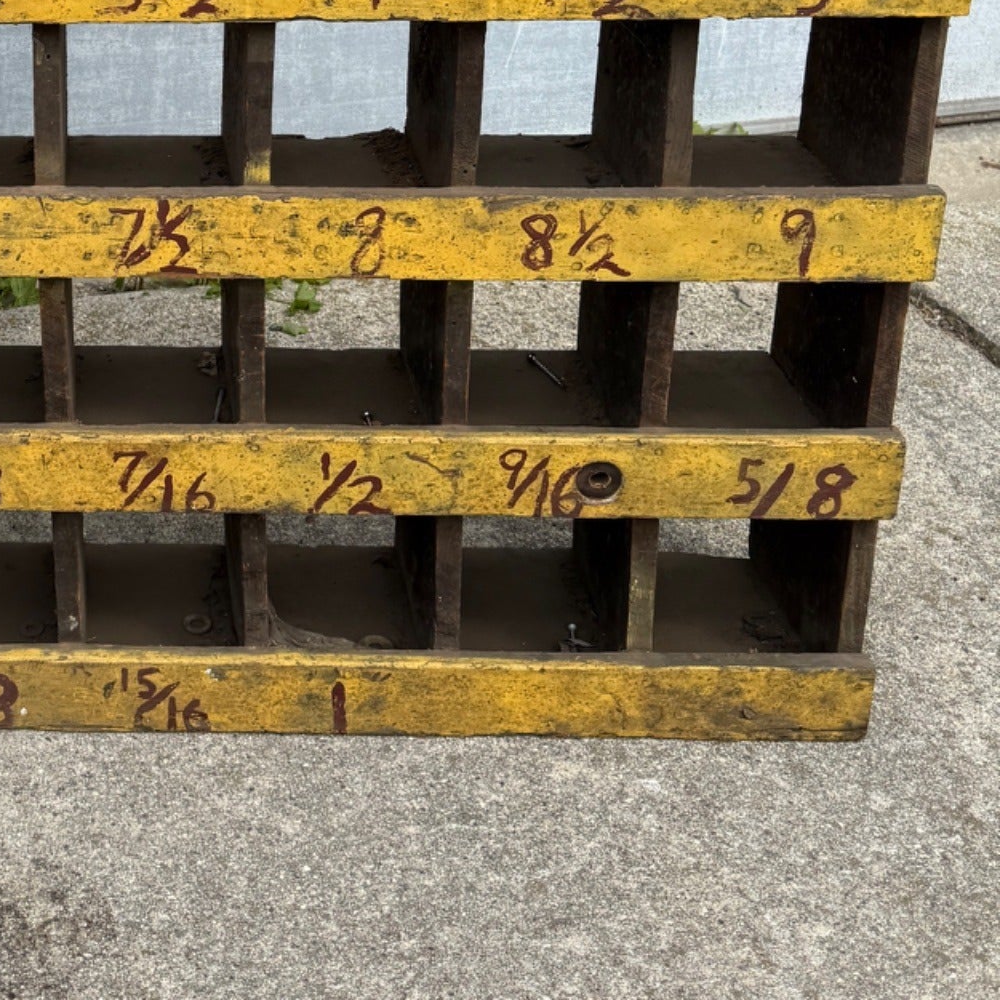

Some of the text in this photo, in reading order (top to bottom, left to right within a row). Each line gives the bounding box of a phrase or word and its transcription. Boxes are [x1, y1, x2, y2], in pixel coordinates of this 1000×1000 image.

[350, 206, 387, 276] 8
[780, 208, 815, 276] 9
[112, 450, 216, 513] 7/16
[307, 452, 394, 515] 1/2
[500, 448, 585, 518] 9/16
[726, 457, 860, 519] 5/8
[120, 667, 211, 733] 15/16
[330, 680, 348, 734] 1
